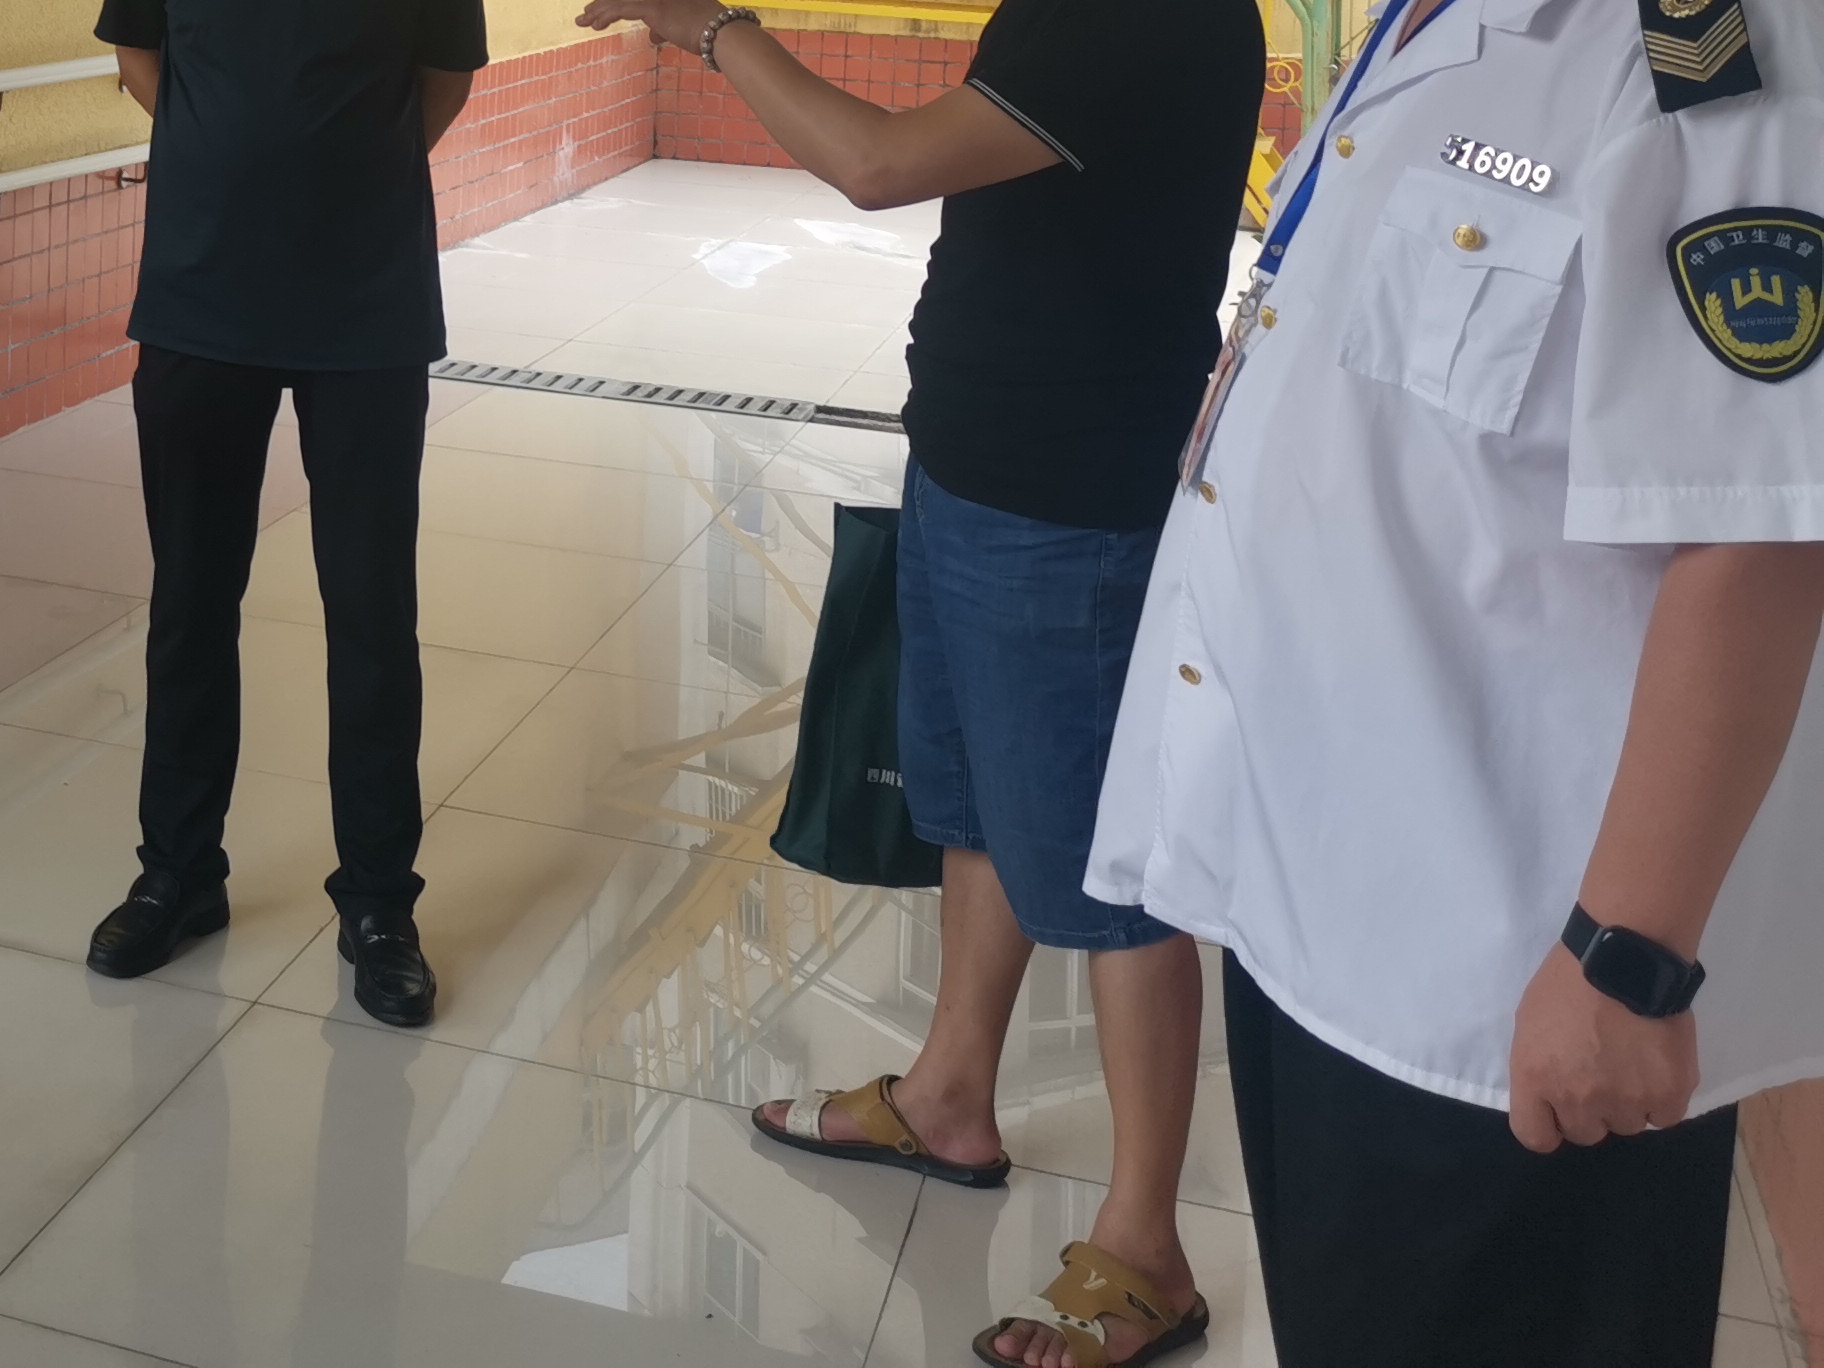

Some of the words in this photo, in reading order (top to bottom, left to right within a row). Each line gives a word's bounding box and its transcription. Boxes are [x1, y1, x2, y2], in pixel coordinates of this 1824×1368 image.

[1440, 133, 1552, 193] 516909
[1689, 227, 1816, 267] 中国卫生监督
